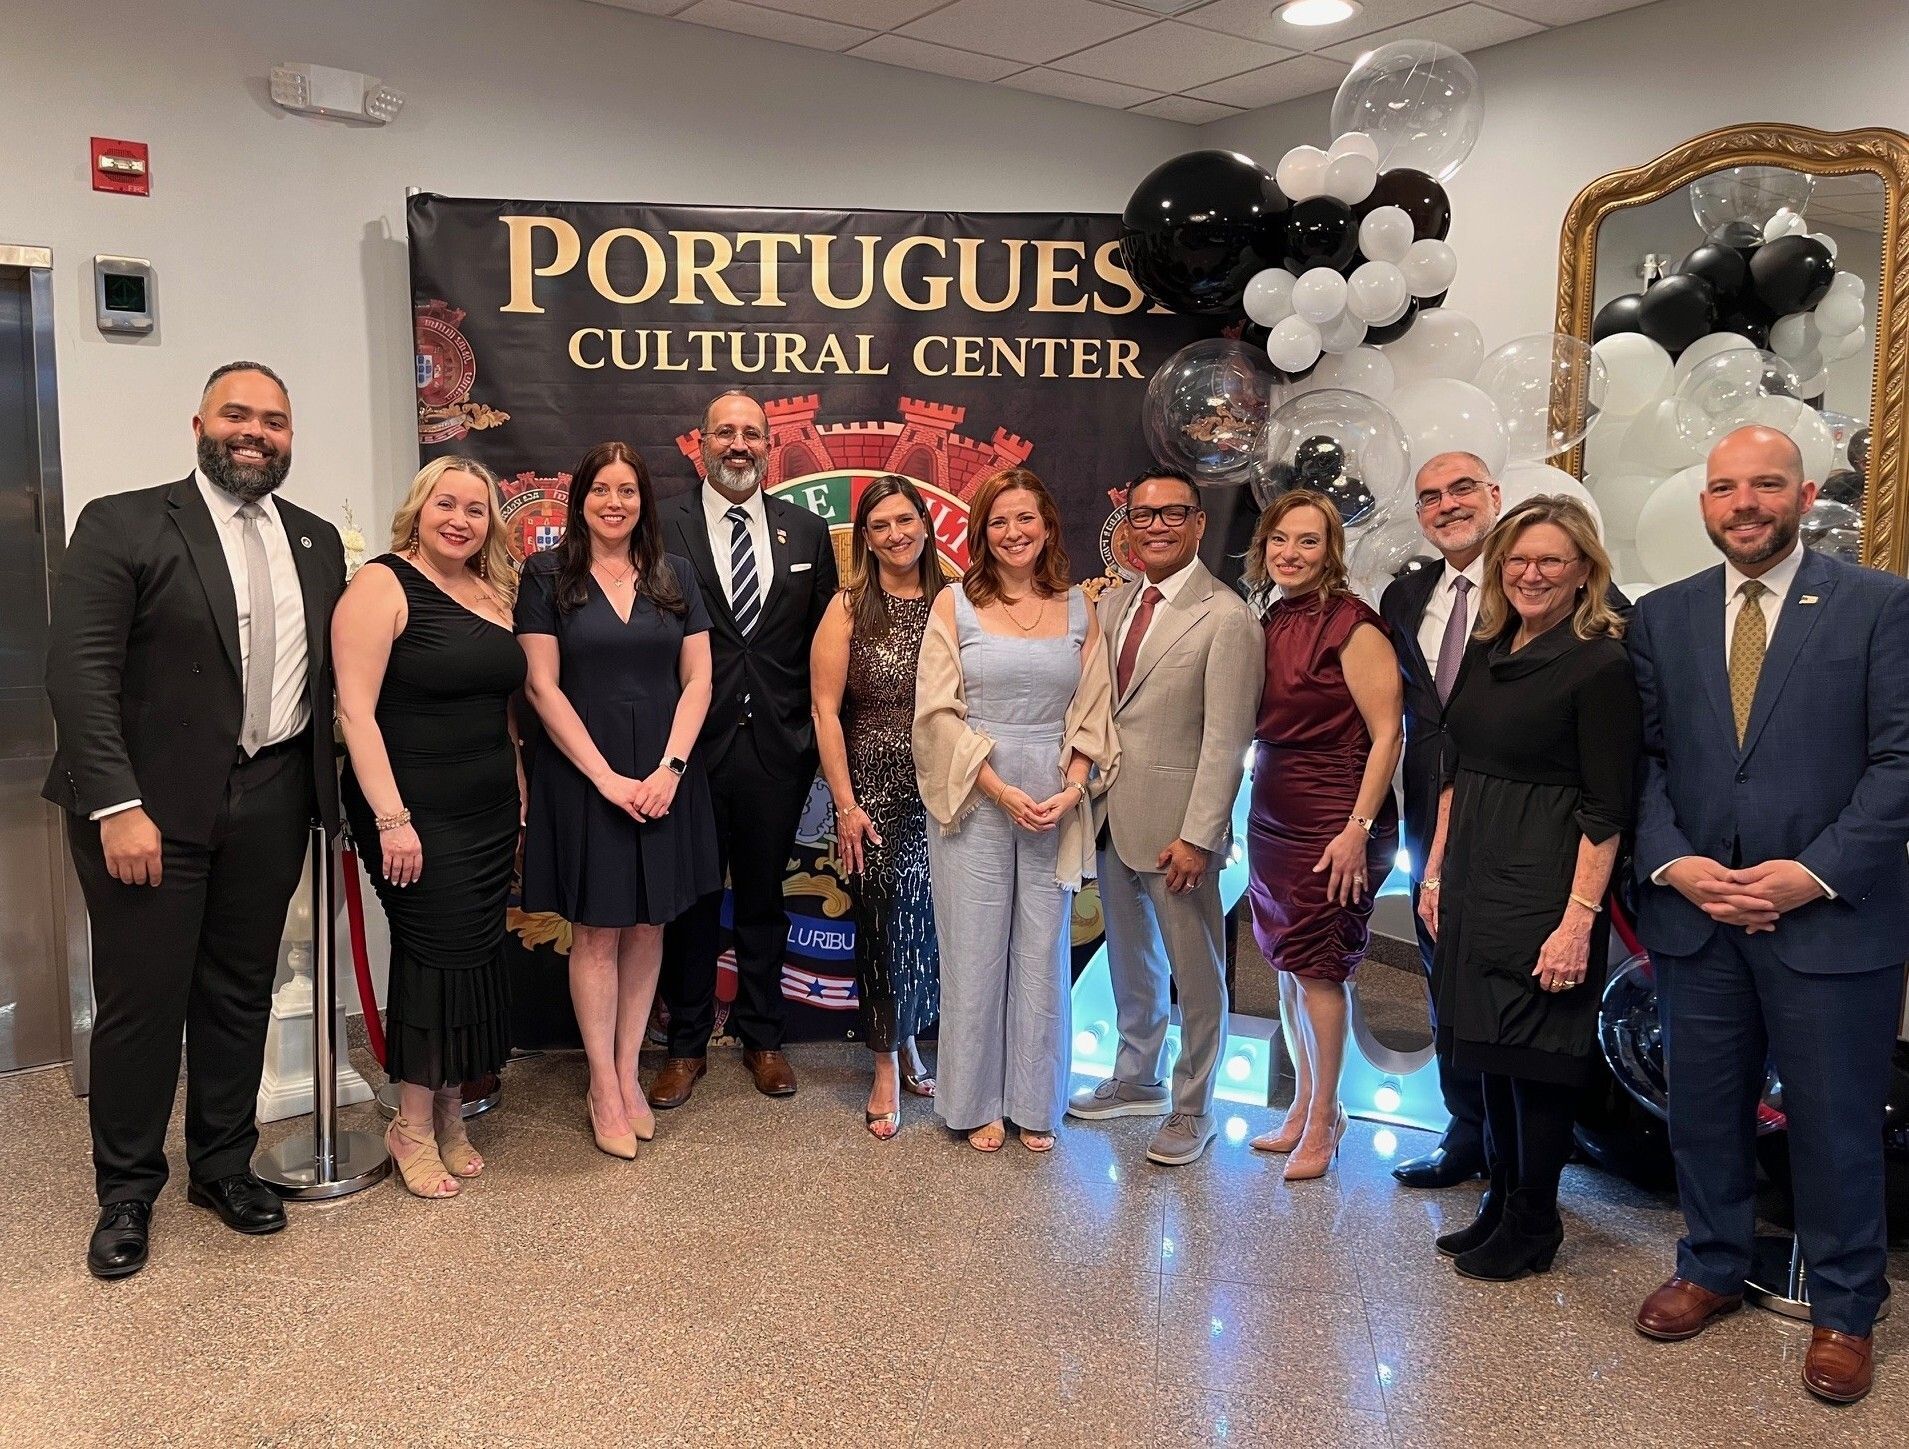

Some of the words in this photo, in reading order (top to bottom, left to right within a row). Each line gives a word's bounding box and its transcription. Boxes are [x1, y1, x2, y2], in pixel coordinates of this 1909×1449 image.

[499, 215, 1176, 315] PORTUGUES
[568, 327, 890, 375] CULTURAL
[912, 335, 1145, 380] CENTER
[786, 923, 856, 951] LURIBU
